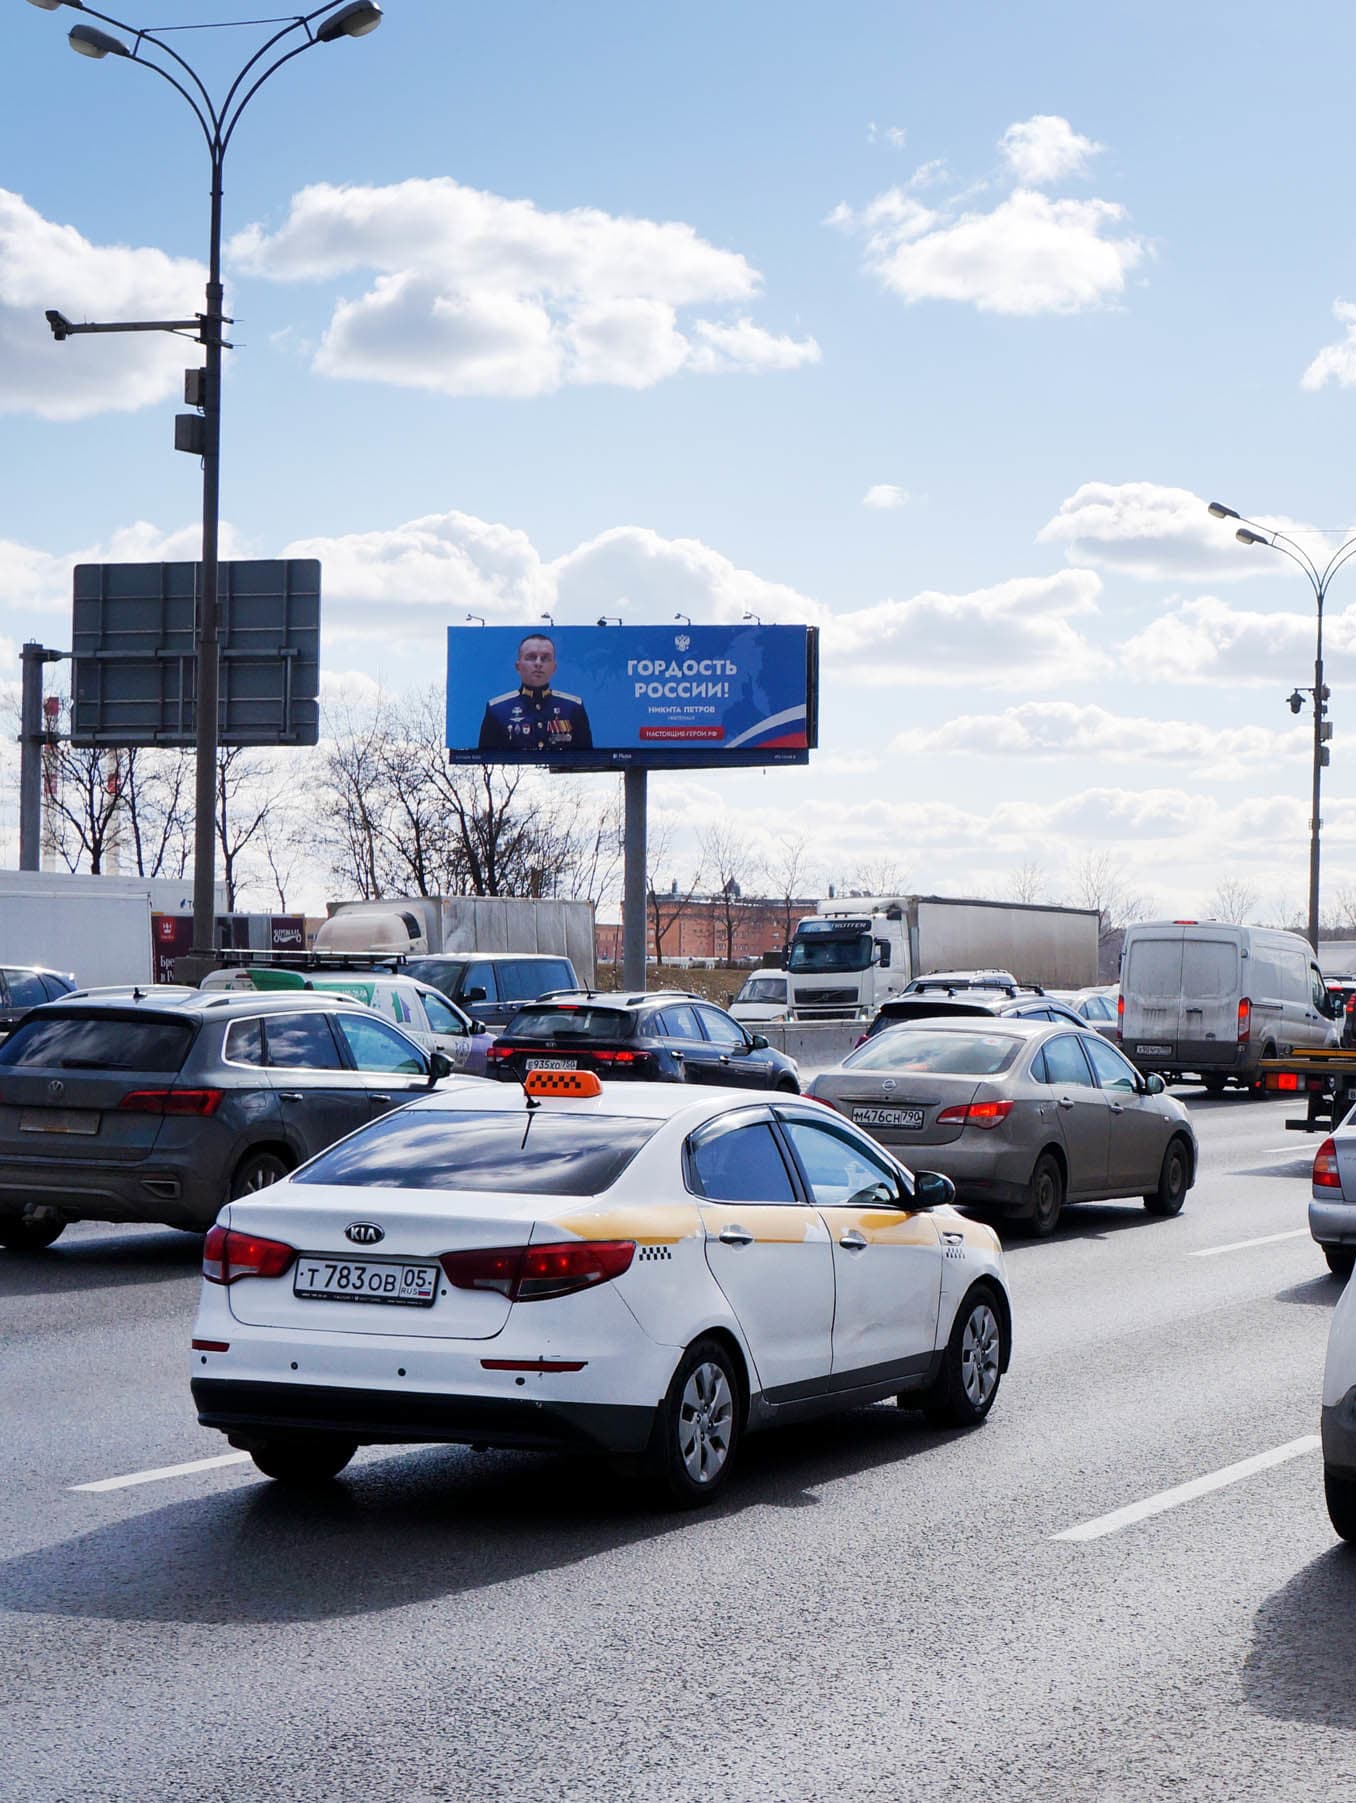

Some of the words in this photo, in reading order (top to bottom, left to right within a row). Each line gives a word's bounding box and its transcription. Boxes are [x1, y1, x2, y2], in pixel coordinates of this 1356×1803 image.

[627, 660, 737, 678] ГОРДОСТЬ
[634, 682, 729, 698] РОССИИ!
[901, 1111, 920, 1122] 790
[350, 1227, 377, 1240] KIA
[307, 1264, 397, 1292] Т783ОВ
[404, 1269, 427, 1287] 05
[400, 1287, 418, 1296] RUS
